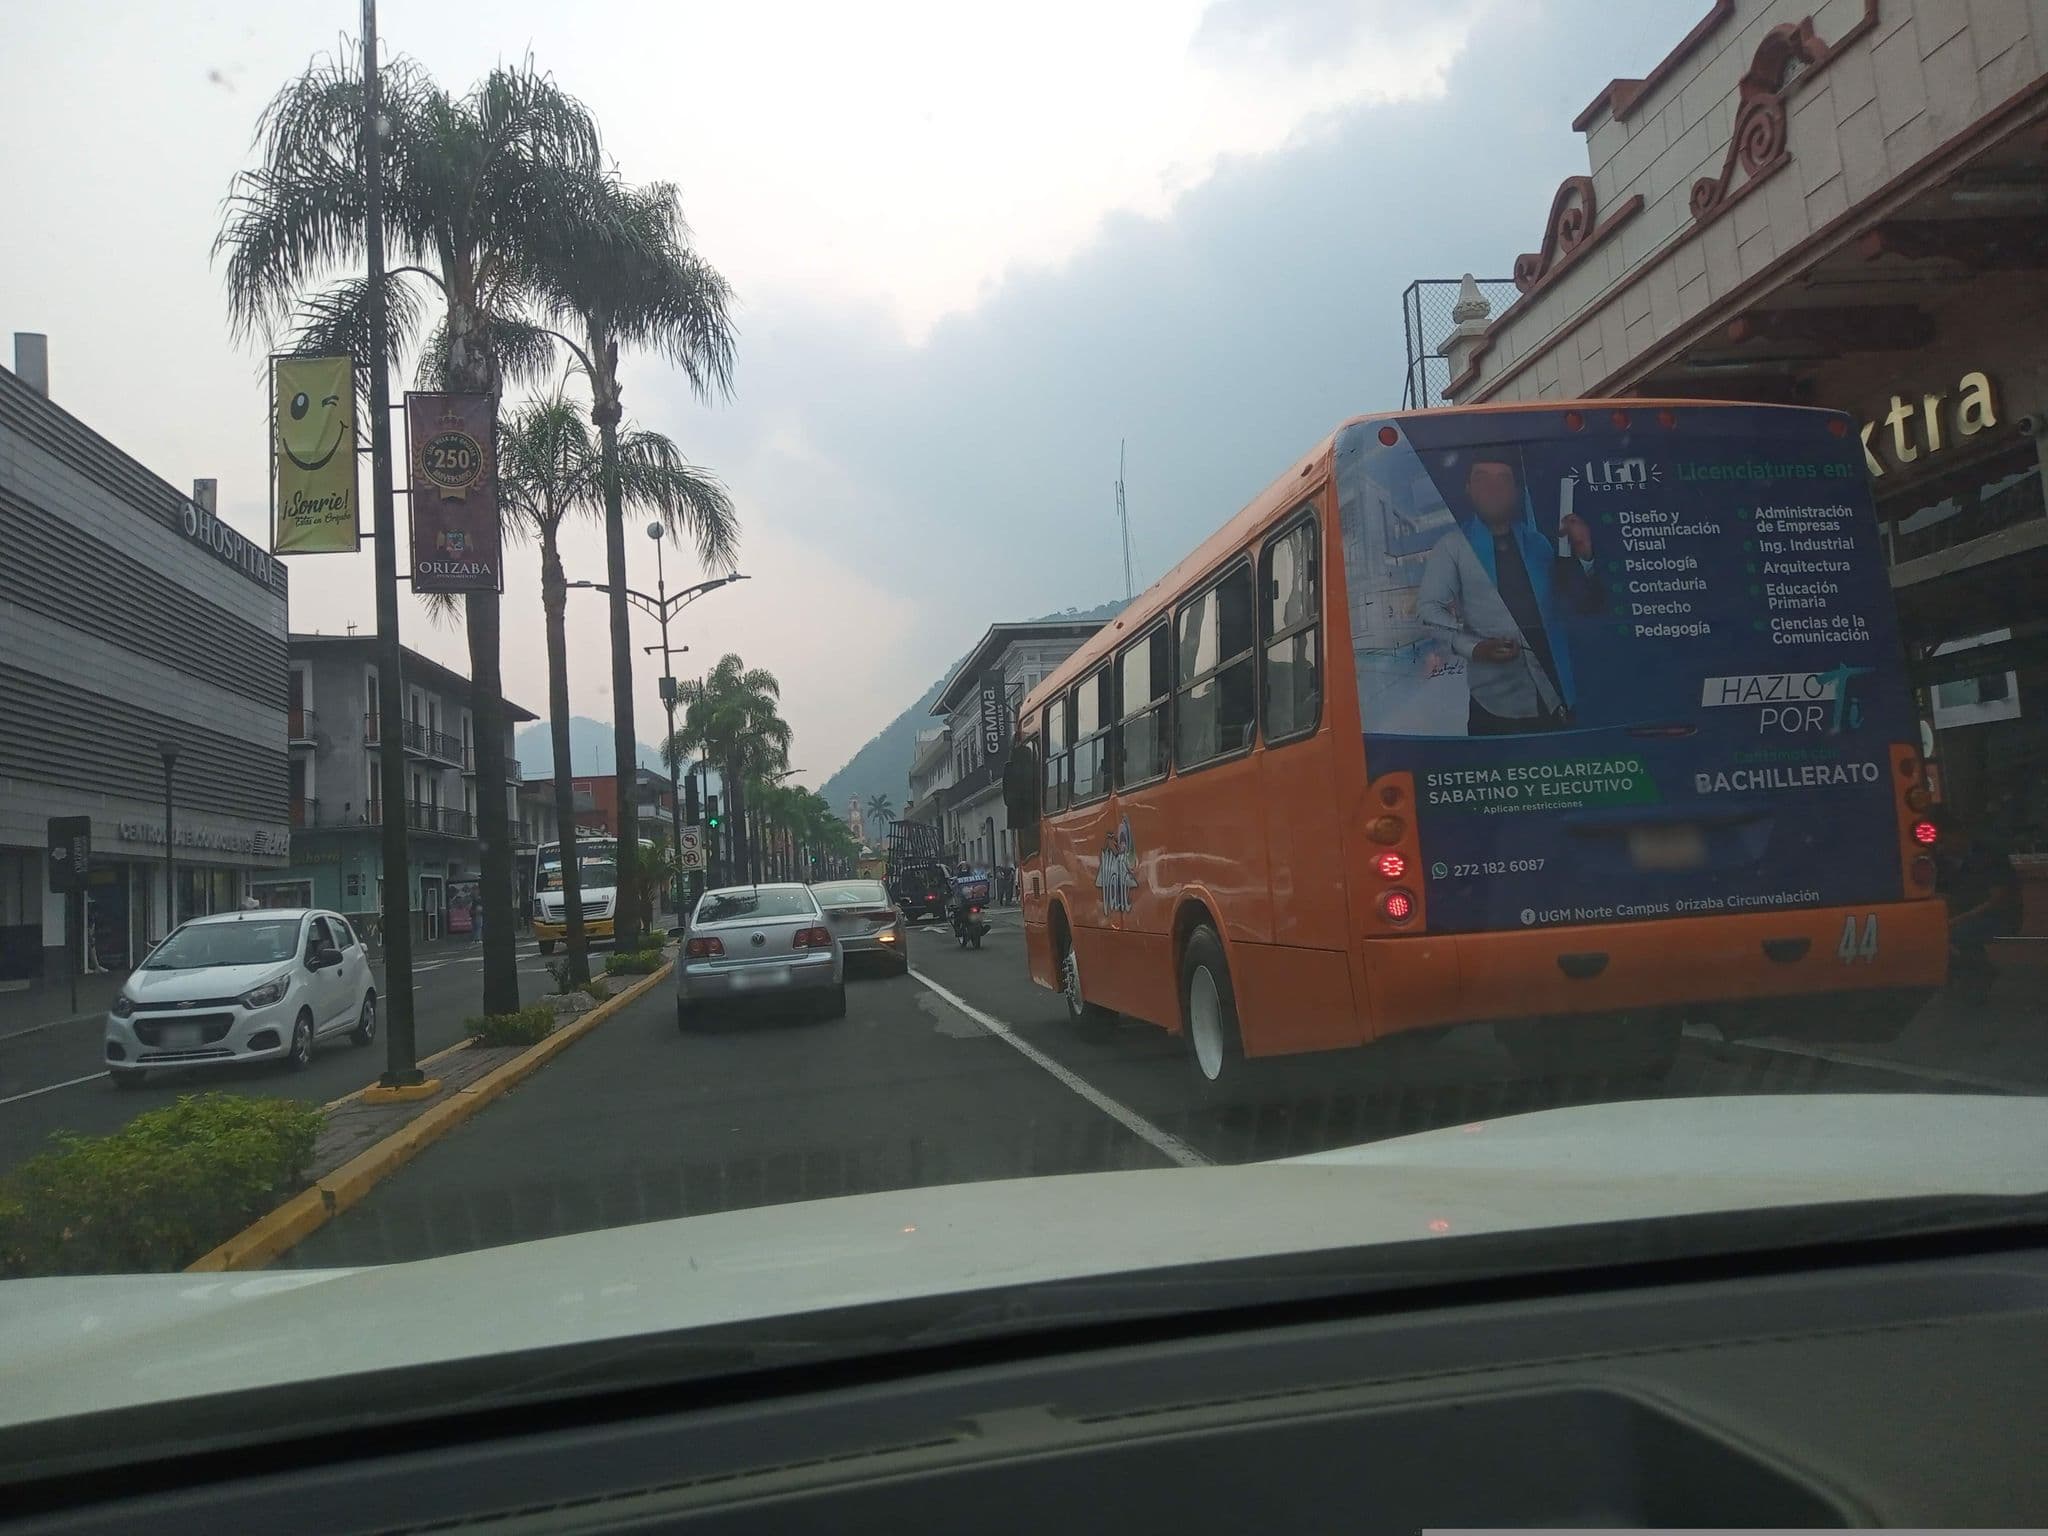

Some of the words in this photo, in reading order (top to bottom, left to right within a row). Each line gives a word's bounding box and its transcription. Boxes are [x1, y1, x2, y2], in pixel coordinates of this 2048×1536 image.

[434, 448, 470, 469] 250
[1678, 460, 1818, 481] Licenciaturas
[1590, 482, 1648, 492] NORTE
[1619, 510, 1668, 524] Diseño
[1670, 511, 1680, 526] y
[1755, 504, 1853, 520] Administración
[1621, 521, 1721, 538] Comunicación
[1756, 519, 1774, 533] de
[1777, 520, 1841, 534] Empresas
[199, 508, 276, 586] HOSPITAL
[1623, 537, 1667, 552] Visual
[1759, 539, 1787, 555] Ing.
[1790, 536, 1855, 551] Industrial
[419, 561, 491, 575] ORIZABA
[1625, 555, 1698, 573] Psicología
[1763, 559, 1851, 576] Arquitectura
[1628, 577, 1707, 594] Contaduría
[1766, 581, 1838, 596] Educación
[1632, 601, 1692, 616] Derecho
[1768, 595, 1827, 610] Primaria
[1634, 621, 1711, 639] Pedagogía
[1771, 617, 1828, 631] Ciencias
[1832, 615, 1850, 629] de
[1852, 614, 1865, 628] la
[1772, 628, 1870, 645] Comunicación
[1721, 673, 1824, 703] HAZLO
[1760, 706, 1824, 734] POR
[1427, 769, 1502, 787] SISTEMA
[1507, 760, 1644, 782] ESCOLARIZADO,
[1695, 762, 1879, 793] BACHILLERATO
[1429, 785, 1519, 804] SABATINO
[1524, 784, 1536, 797] Y
[1541, 778, 1633, 796] EJECUTIVO
[1483, 803, 1520, 815] Aplican
[1522, 800, 1583, 812] restricciones
[1454, 863, 1480, 877] 272
[1482, 861, 1506, 875] 182
[1509, 858, 1545, 873] 6087
[1539, 908, 1571, 924] UGM
[1575, 905, 1613, 920] Norte
[1616, 901, 1670, 917] Campus
[1675, 897, 1724, 913] Orizaba
[1727, 889, 1820, 908] Circunvalación
[1838, 913, 1878, 963] 44
